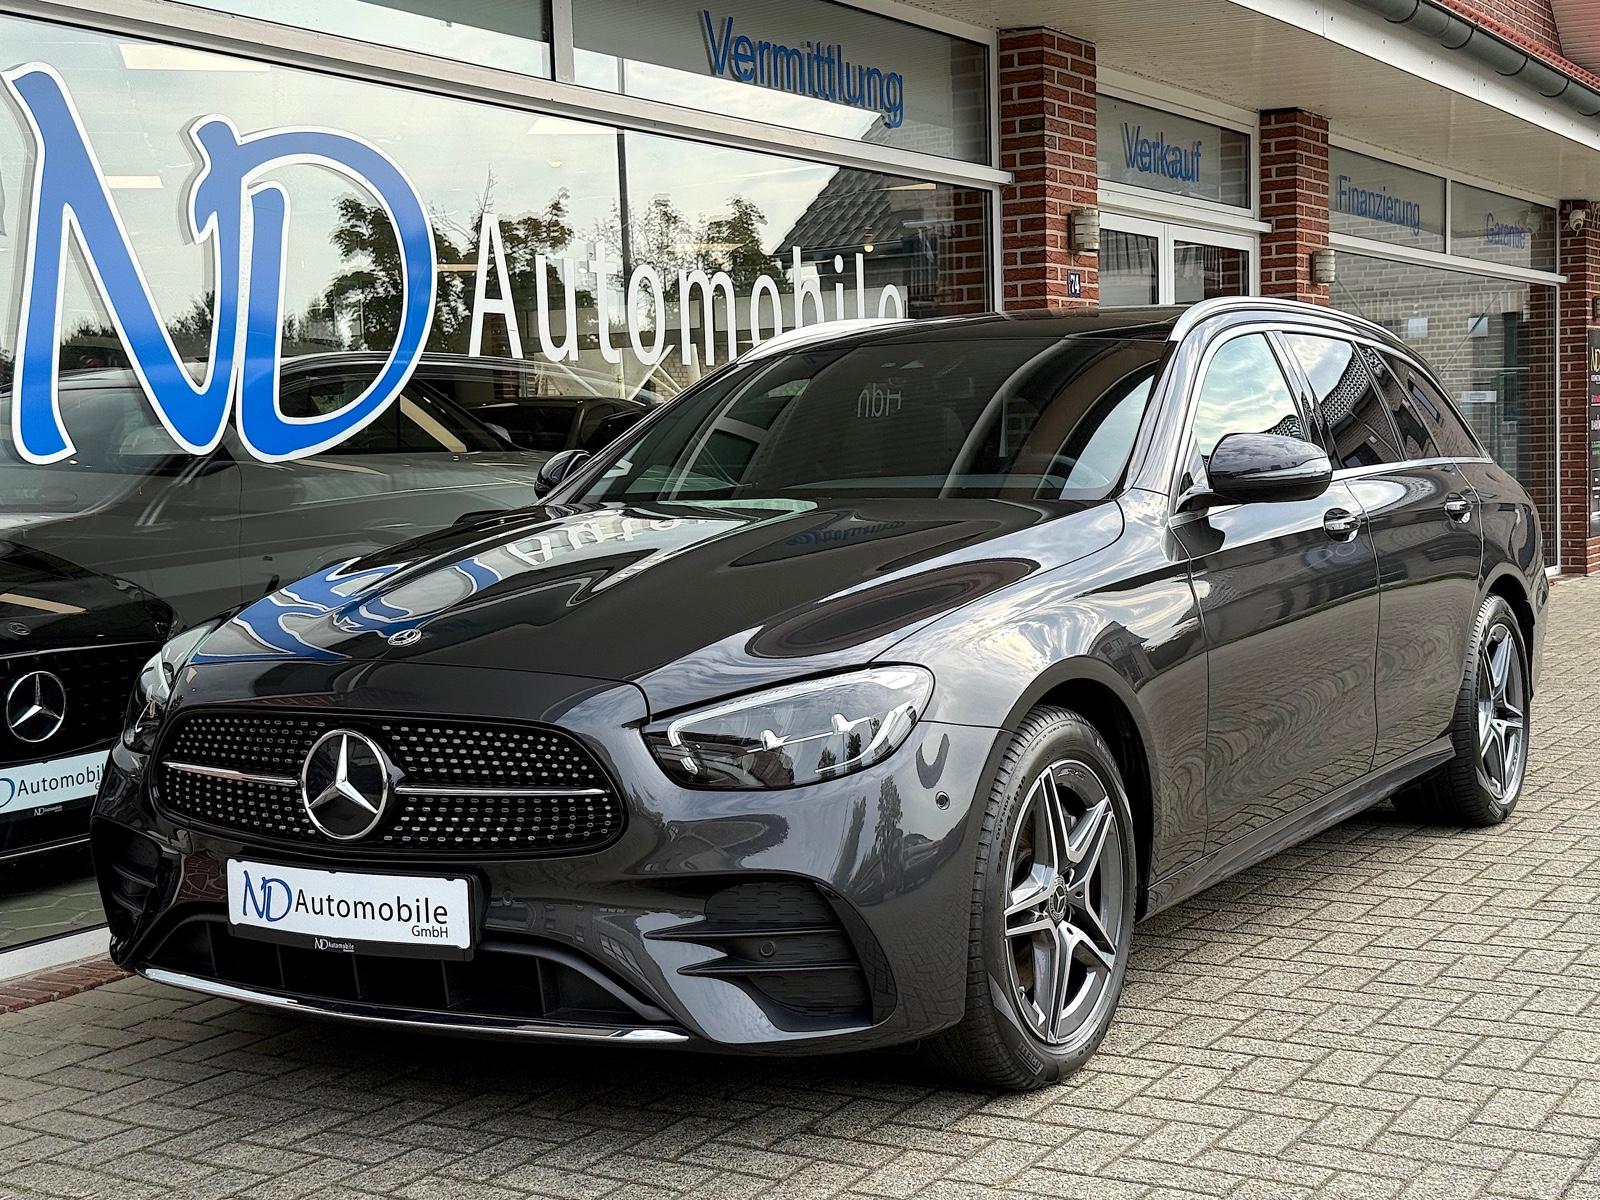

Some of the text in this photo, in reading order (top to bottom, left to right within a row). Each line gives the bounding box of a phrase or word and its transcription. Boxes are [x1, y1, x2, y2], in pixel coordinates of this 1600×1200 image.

[702, 10, 904, 128] Vermittlung
[1123, 122, 1202, 182] Verkauf
[1336, 174, 1420, 236] Finanzierung
[1486, 212, 1525, 249] Garantie
[1, 62, 438, 464] ND
[1070, 274, 1080, 294] 74
[17, 762, 105, 797] Automobil
[243, 870, 448, 924] ND Automobile
[314, 937, 328, 950] ND
[411, 925, 449, 938] GmbH
